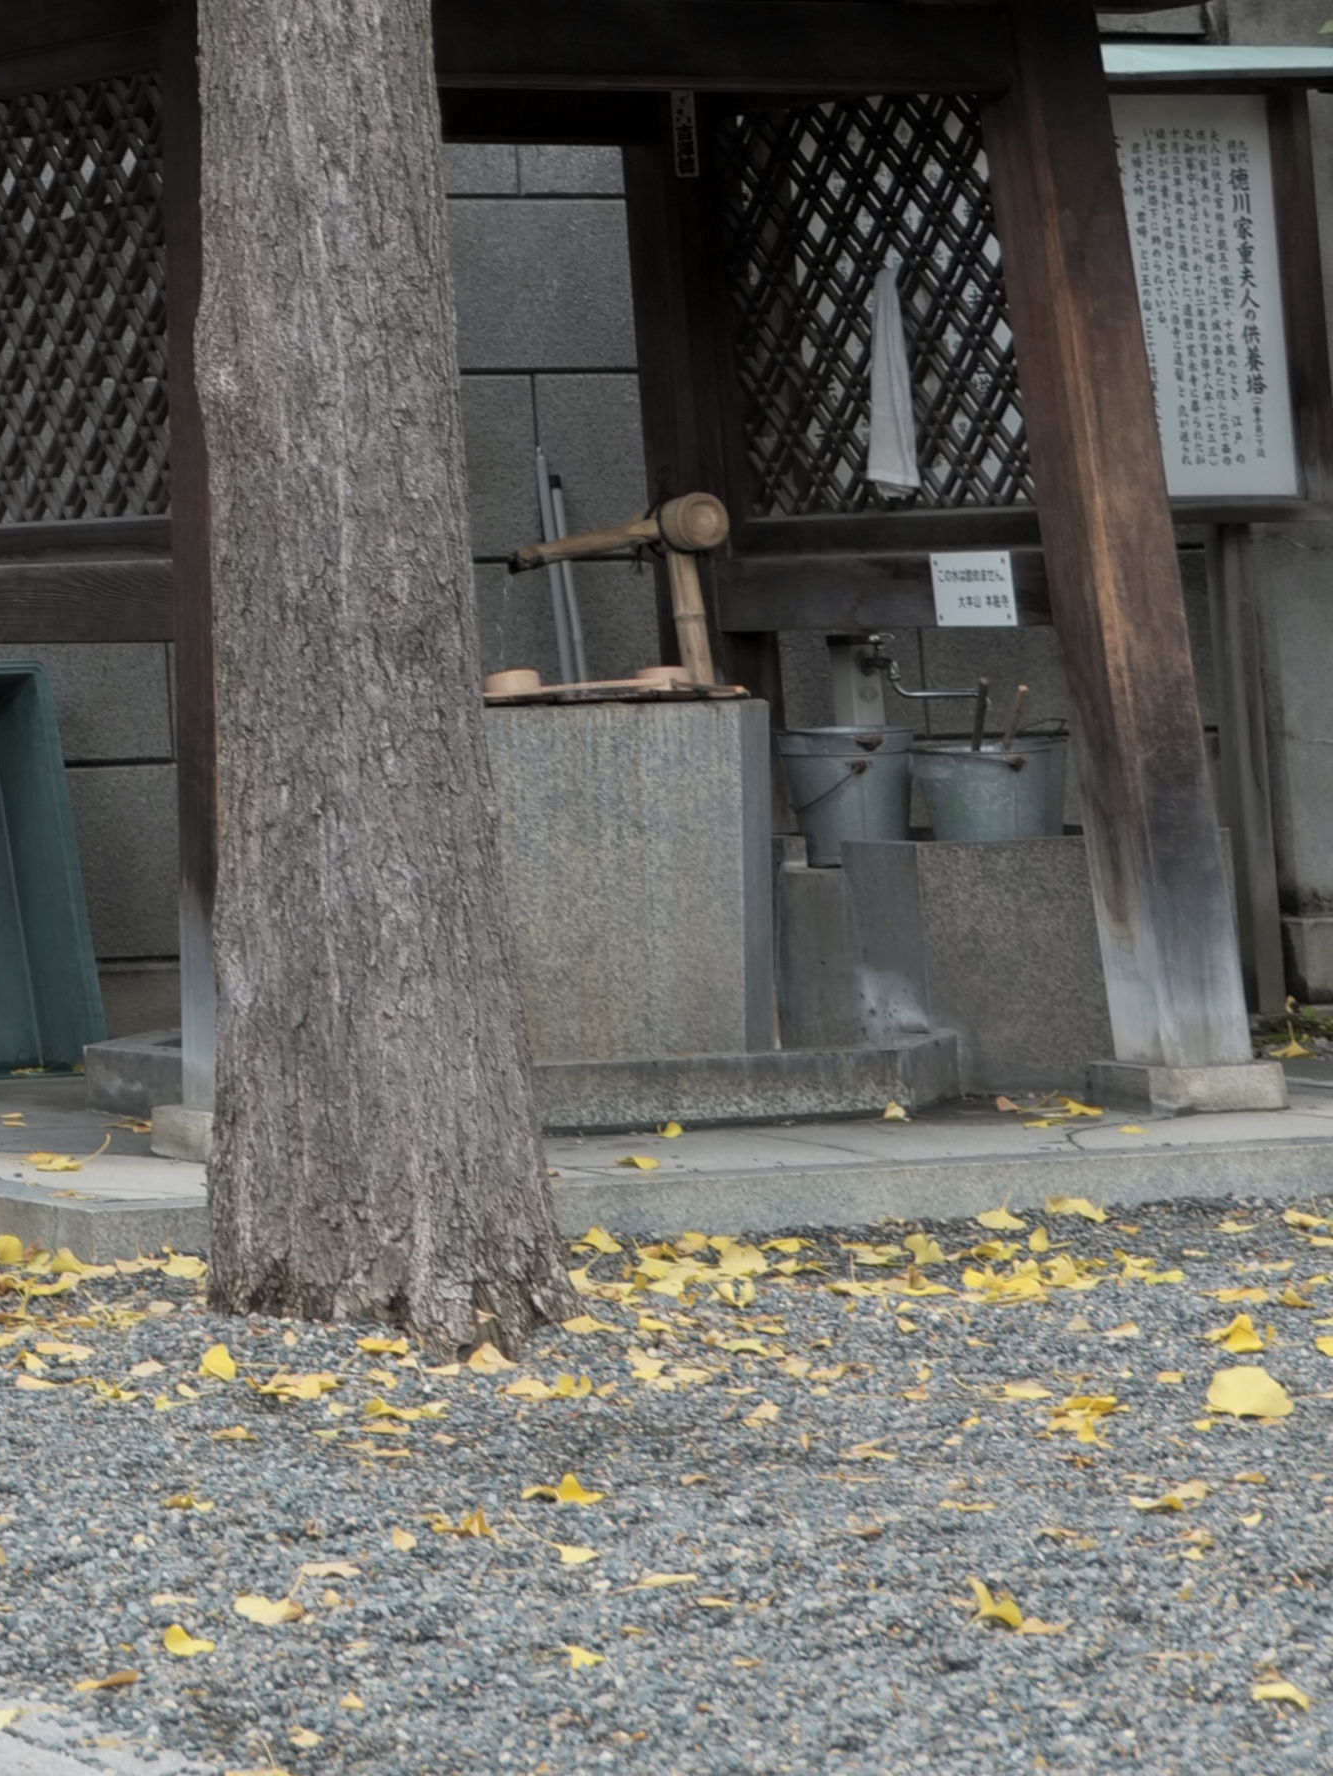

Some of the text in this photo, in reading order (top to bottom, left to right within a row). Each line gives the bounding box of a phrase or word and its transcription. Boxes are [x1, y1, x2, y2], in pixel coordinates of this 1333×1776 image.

[1227, 166, 1268, 394] 徳川家重夫人の供養塔
